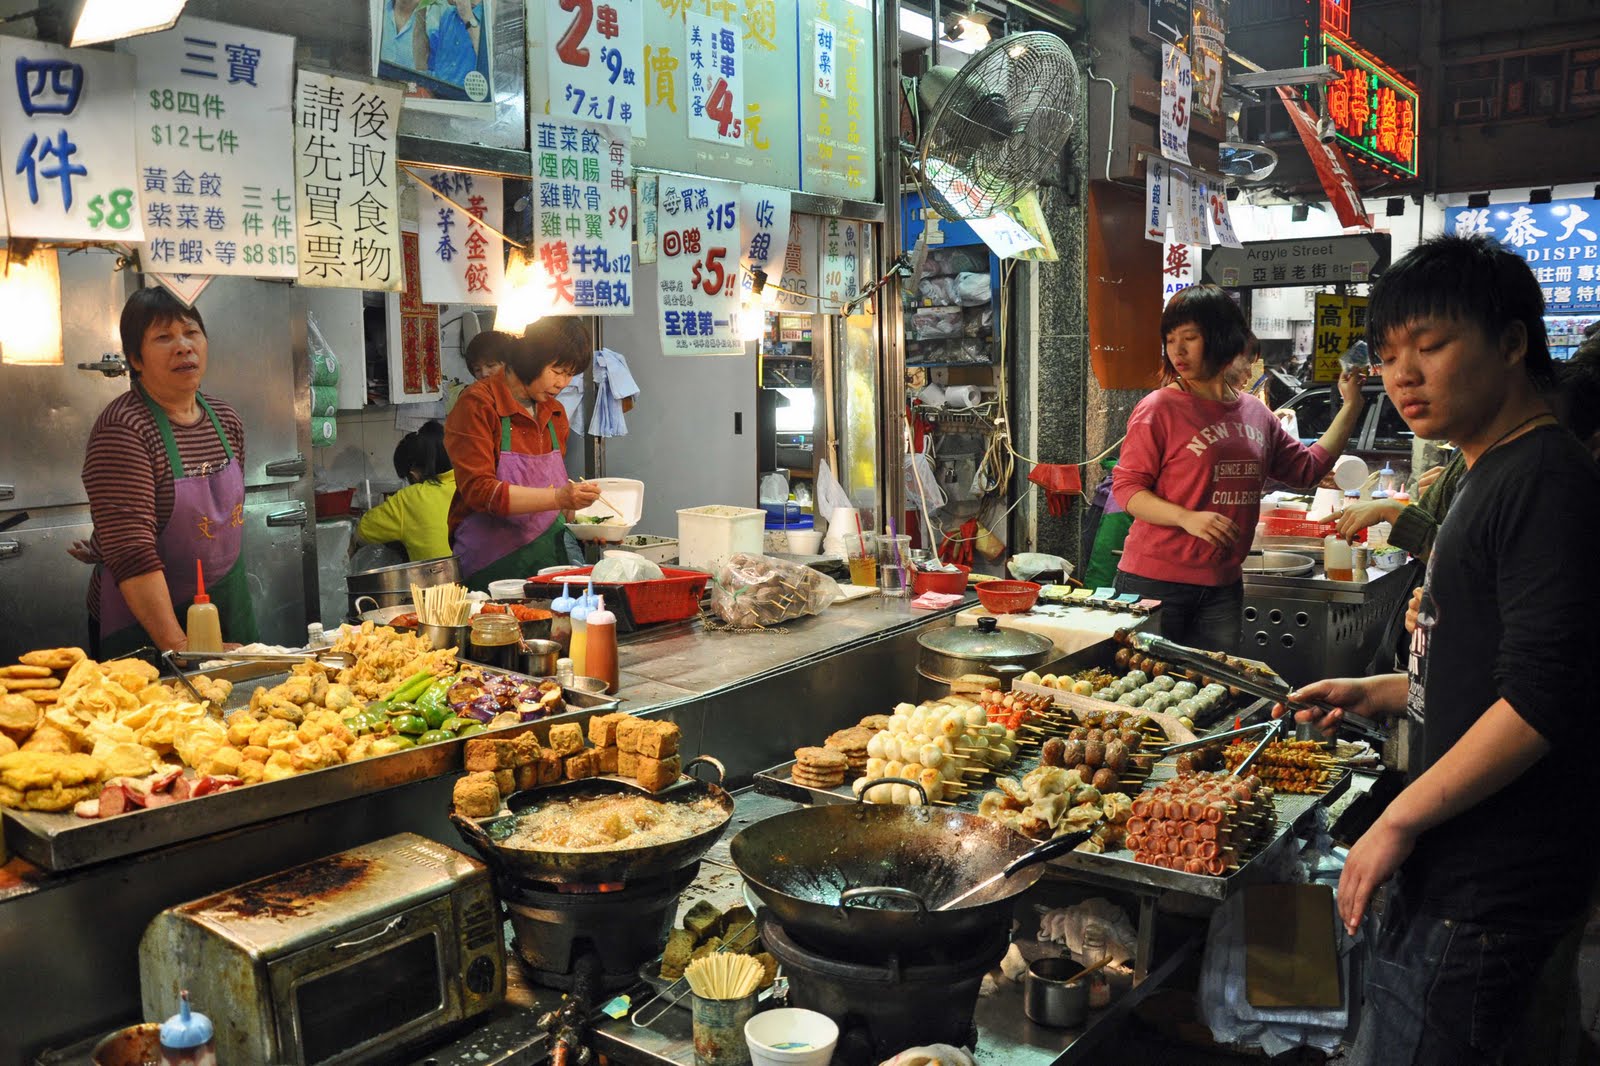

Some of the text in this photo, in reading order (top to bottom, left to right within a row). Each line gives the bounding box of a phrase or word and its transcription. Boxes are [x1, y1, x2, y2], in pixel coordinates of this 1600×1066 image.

[181, 37, 262, 87] 三寶
[720, 28, 735, 78] 每串
[643, 44, 679, 113] 價
[690, 25, 704, 117] 美味魚蛋
[818, 78, 831, 92] 8元
[150, 90, 226, 119] $8四件
[16, 56, 87, 214] 四件
[151, 127, 239, 154] $12七件
[302, 83, 346, 279] 請先買票
[539, 152, 600, 183] 煙肉腸
[608, 141, 625, 192] 每串
[143, 167, 221, 197] 黃金餃
[349, 92, 391, 282] 後取食物
[540, 181, 601, 211] 雞軟骨
[88, 188, 134, 231] $8
[147, 202, 226, 230] 紫菜卷
[242, 186, 263, 236] 三件
[272, 189, 293, 239] 七件
[608, 205, 628, 229] $9
[707, 201, 735, 230] $15
[435, 208, 457, 261] 芋香
[541, 212, 602, 238] 雞中翼
[243, 244, 263, 265] $8
[268, 245, 296, 266] $15
[663, 227, 701, 257] 回贈
[1247, 244, 1333, 261] Argyle Street
[1526, 245, 1598, 262] DISPE
[540, 240, 575, 305] 特大
[572, 244, 611, 273] 牛丸
[844, 227, 857, 298] 魚肉湯
[1253, 264, 1327, 283] 亞皆老街
[574, 279, 630, 307] 墨魚丸
[825, 271, 841, 287] $10
[1187, 422, 1229, 457] NEW
[1219, 463, 1241, 475] SINCE
[1211, 490, 1258, 505] COLLEGE
[197, 503, 244, 539] 文記
